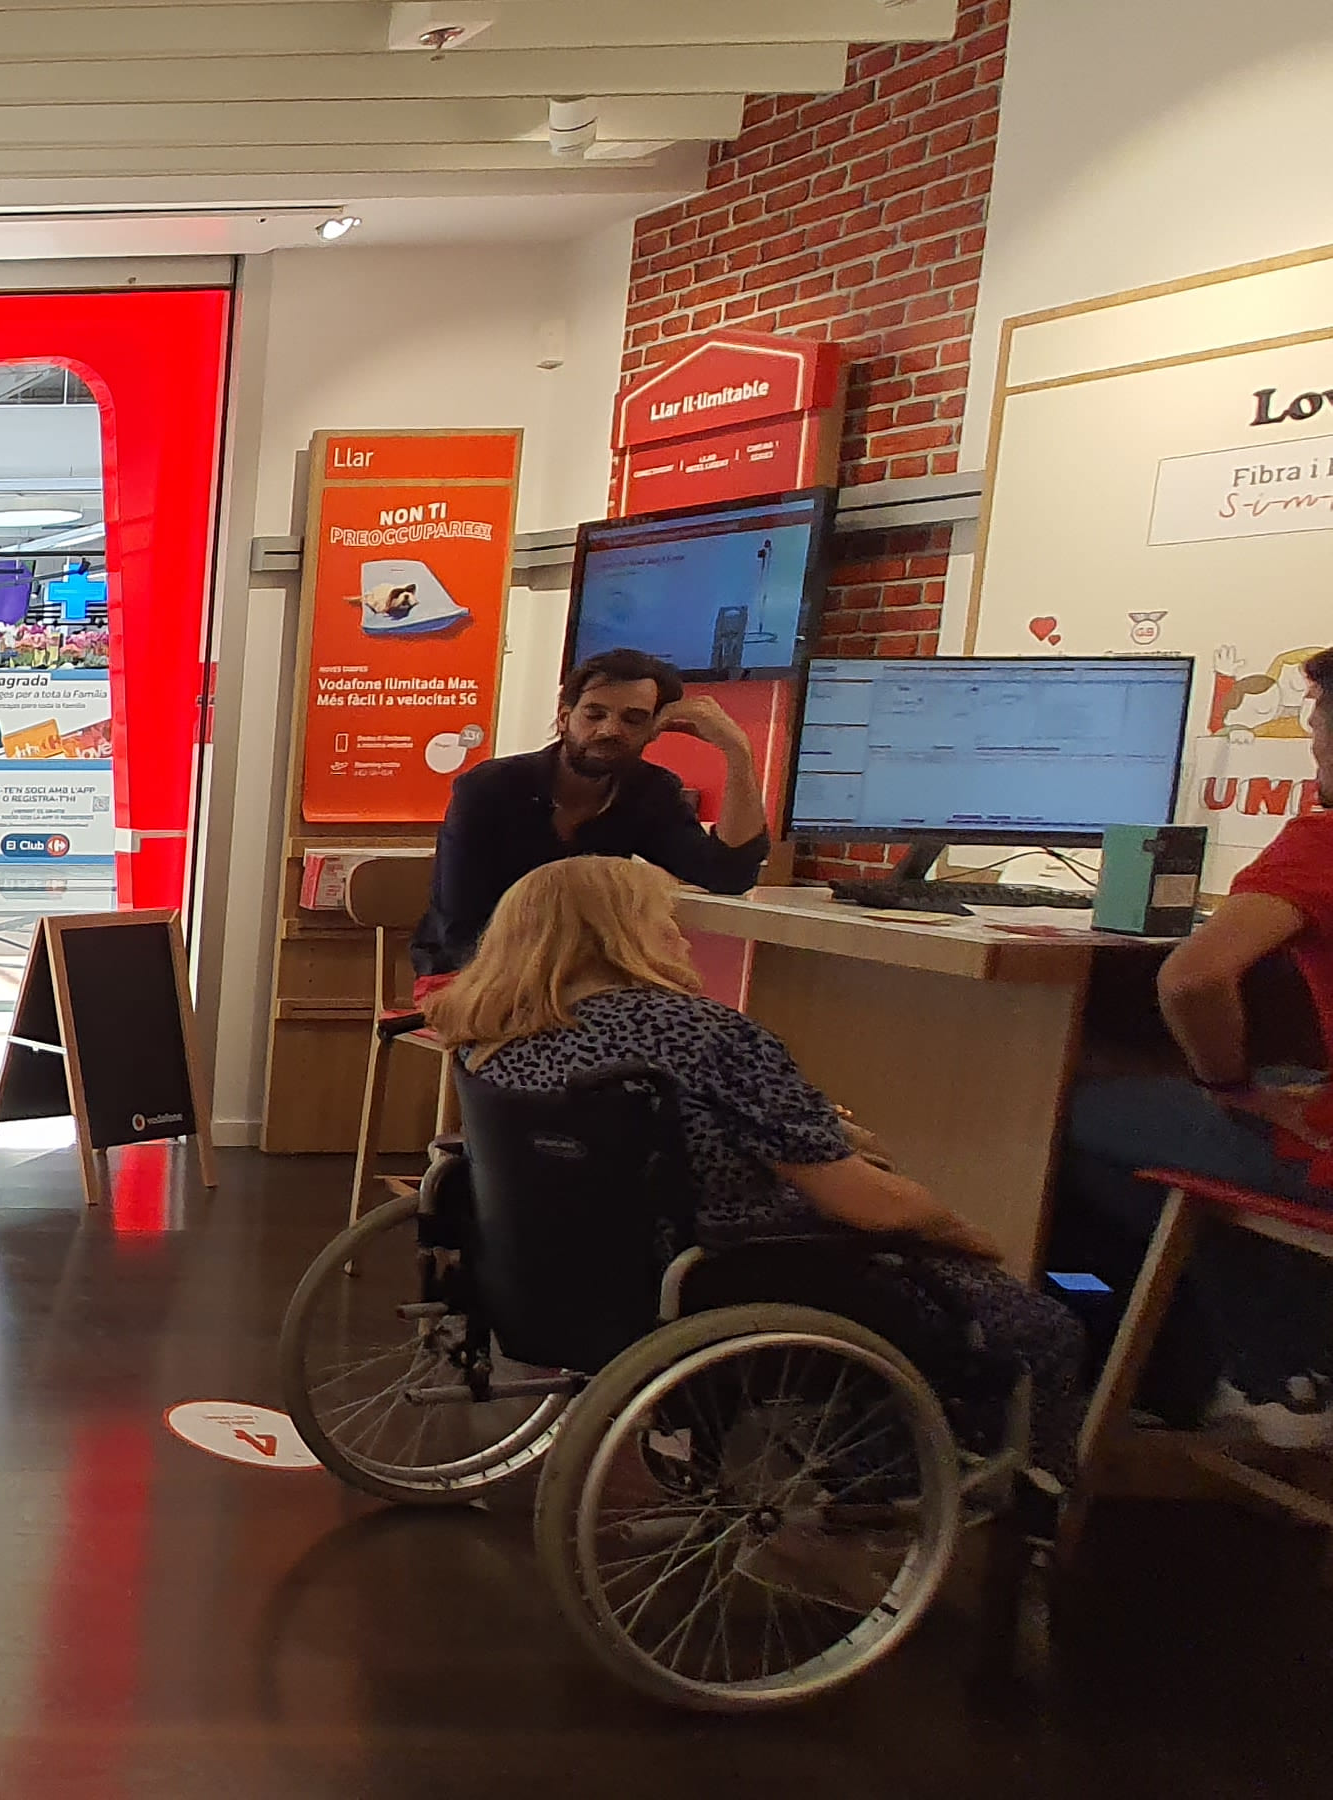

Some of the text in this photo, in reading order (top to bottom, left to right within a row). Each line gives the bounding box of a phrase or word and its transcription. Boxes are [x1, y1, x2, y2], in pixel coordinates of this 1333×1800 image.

[650, 402, 683, 421] Llar
[334, 447, 374, 468] Llar
[1233, 458, 1318, 487] Fibra i
[379, 502, 448, 526] NON TI
[318, 677, 478, 690] Vodafone Ilimitada Max.
[16, 692, 32, 700] per
[42, 690, 62, 699] tota
[64, 690, 71, 699] la
[73, 689, 108, 699] Família
[317, 693, 344, 706] Més
[347, 693, 376, 706] fàcil
[386, 696, 394, 706] a
[397, 694, 456, 706] velocitat
[458, 693, 478, 706] 5G
[24, 786, 46, 794] SOCI
[6, 840, 45, 850] El Club
